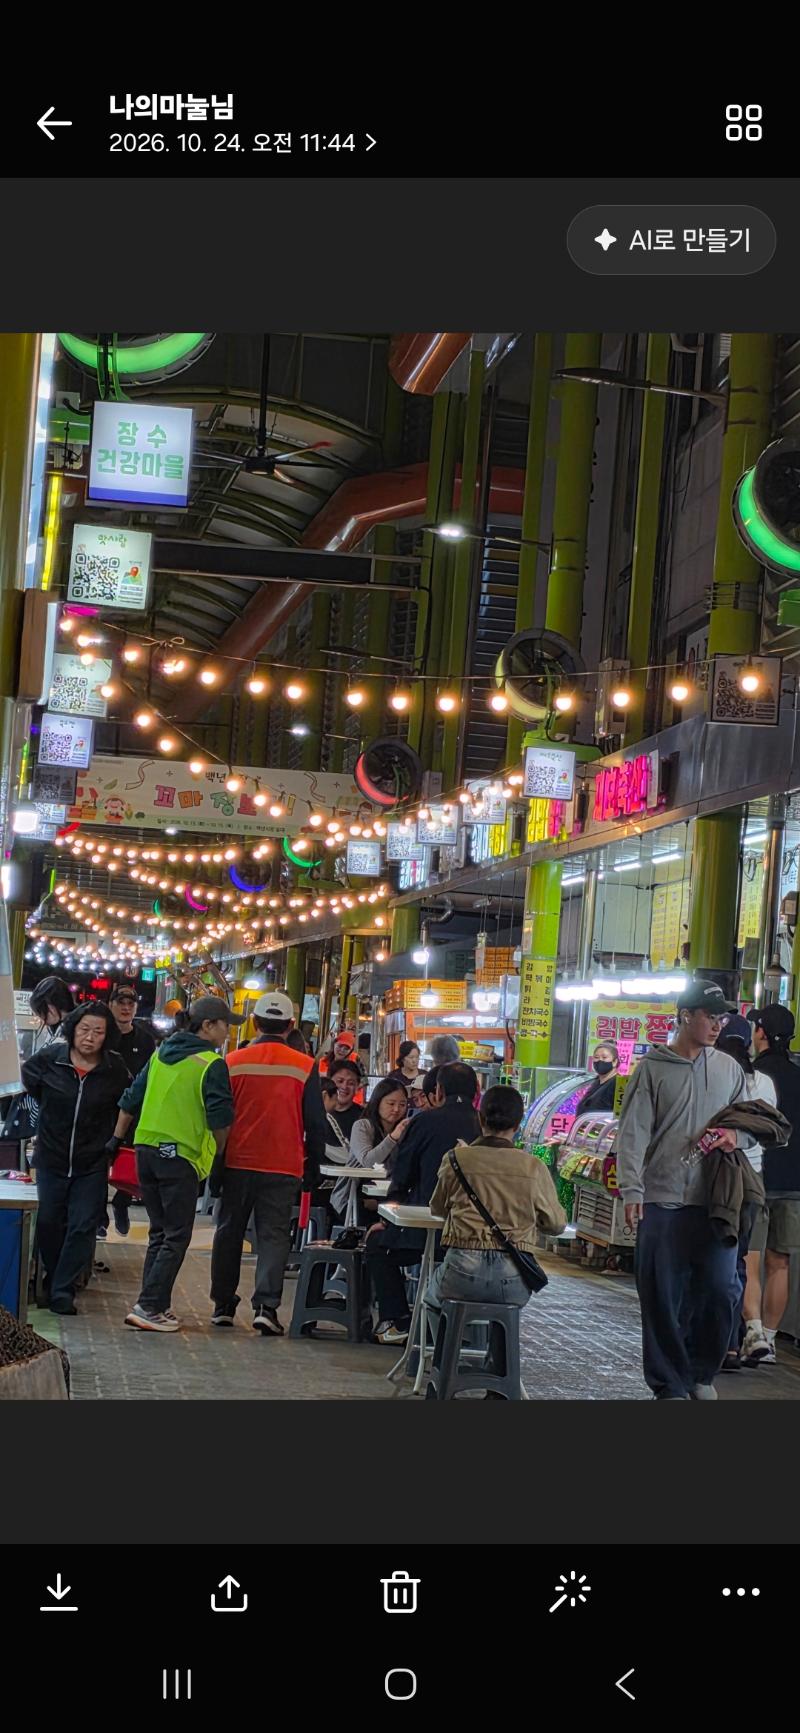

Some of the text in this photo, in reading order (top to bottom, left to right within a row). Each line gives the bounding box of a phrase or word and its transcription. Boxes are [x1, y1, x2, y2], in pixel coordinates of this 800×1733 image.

[97, 448, 184, 479] 건강마을
[154, 784, 204, 809] 꼬마
[596, 1016, 641, 1040] 김밥
